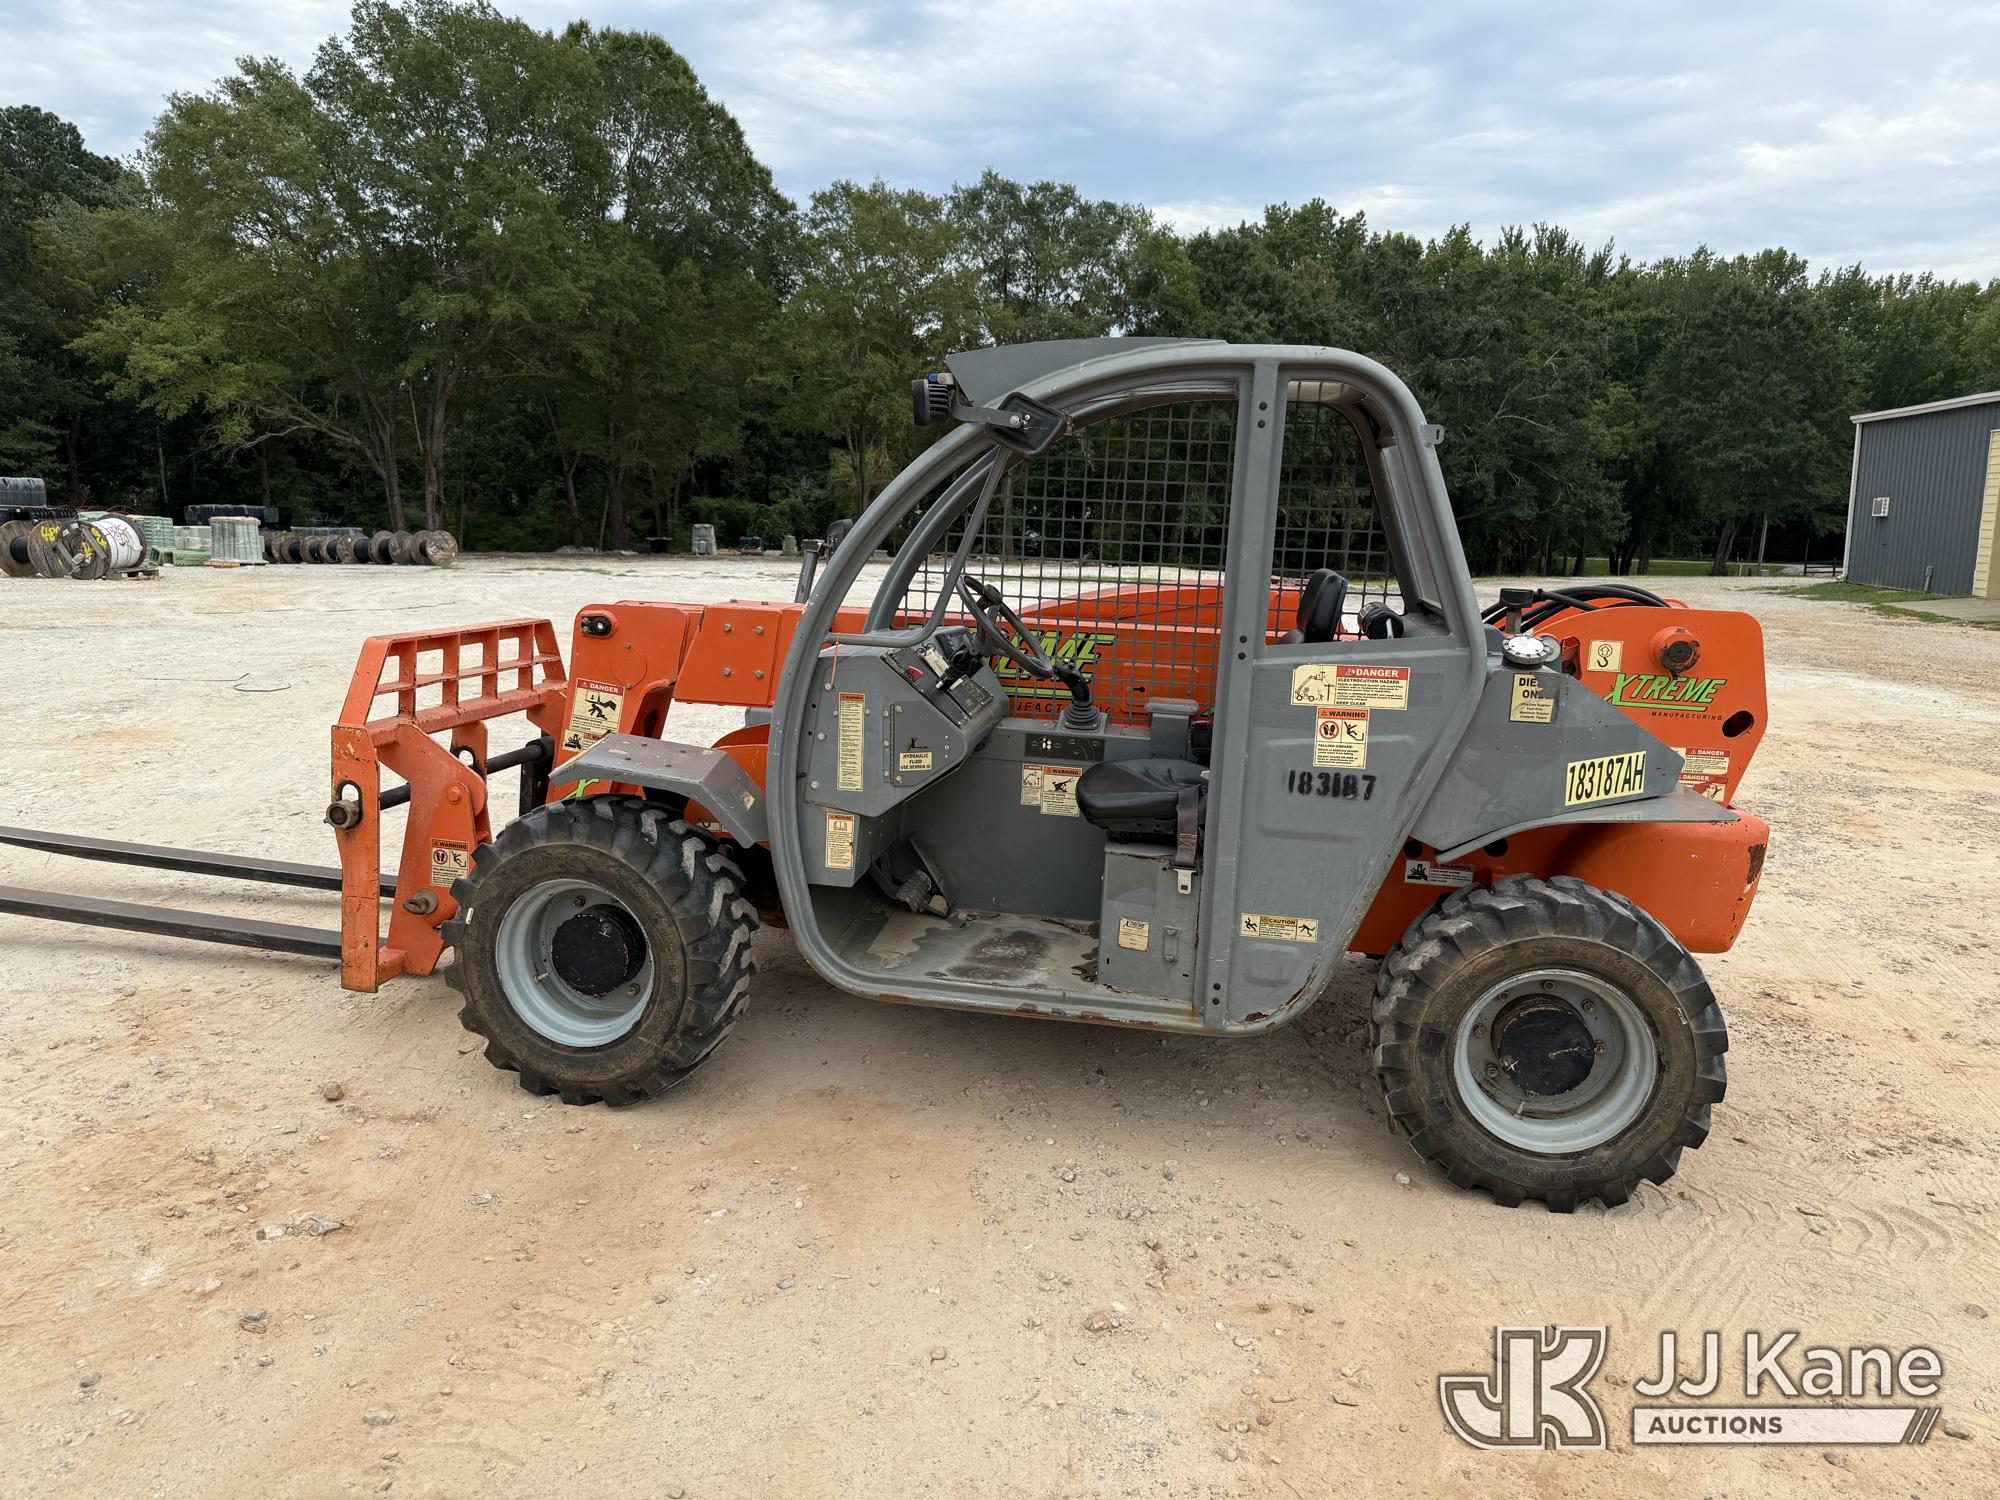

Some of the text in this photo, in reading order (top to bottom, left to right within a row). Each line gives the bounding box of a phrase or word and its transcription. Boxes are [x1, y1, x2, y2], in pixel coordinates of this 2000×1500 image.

[1356, 669, 1399, 678] DANGER
[1519, 677, 1538, 687] DIE
[590, 682, 620, 694] DANGER
[1603, 672, 1728, 706] XTREME
[1651, 711, 1724, 721] MANUFACTURING
[1053, 768, 1079, 776] WARNING
[1568, 753, 1646, 802] 183187AH
[1288, 770, 1377, 801] 183187
[440, 841, 467, 850] WARNING
[1269, 918, 1296, 926] CAUTION
